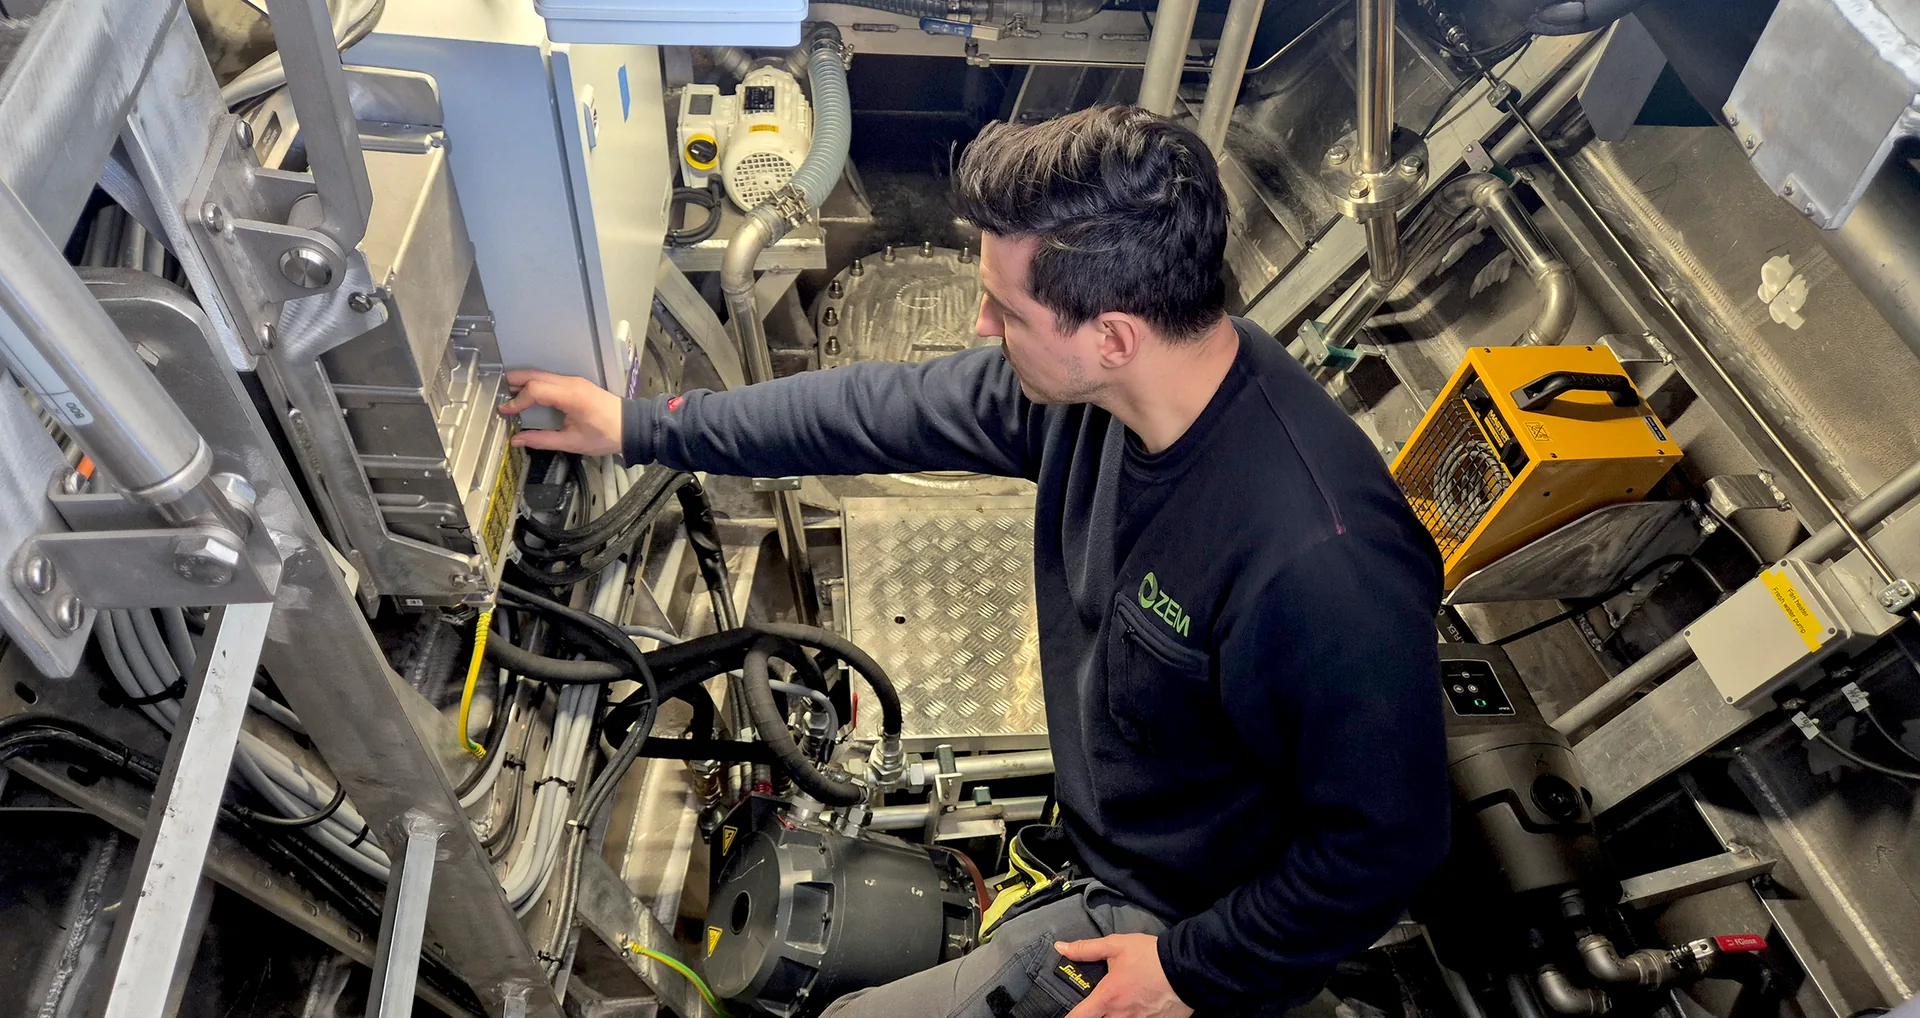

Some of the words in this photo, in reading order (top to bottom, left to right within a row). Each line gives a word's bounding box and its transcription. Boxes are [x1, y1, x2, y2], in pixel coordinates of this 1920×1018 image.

[1487, 409, 1510, 442] MASTER
[1772, 586, 1785, 604] Fresh
[1783, 603, 1796, 618] water
[1792, 617, 1806, 634] pump
[1787, 588, 1797, 601] Fan
[1794, 599, 1809, 617] heater
